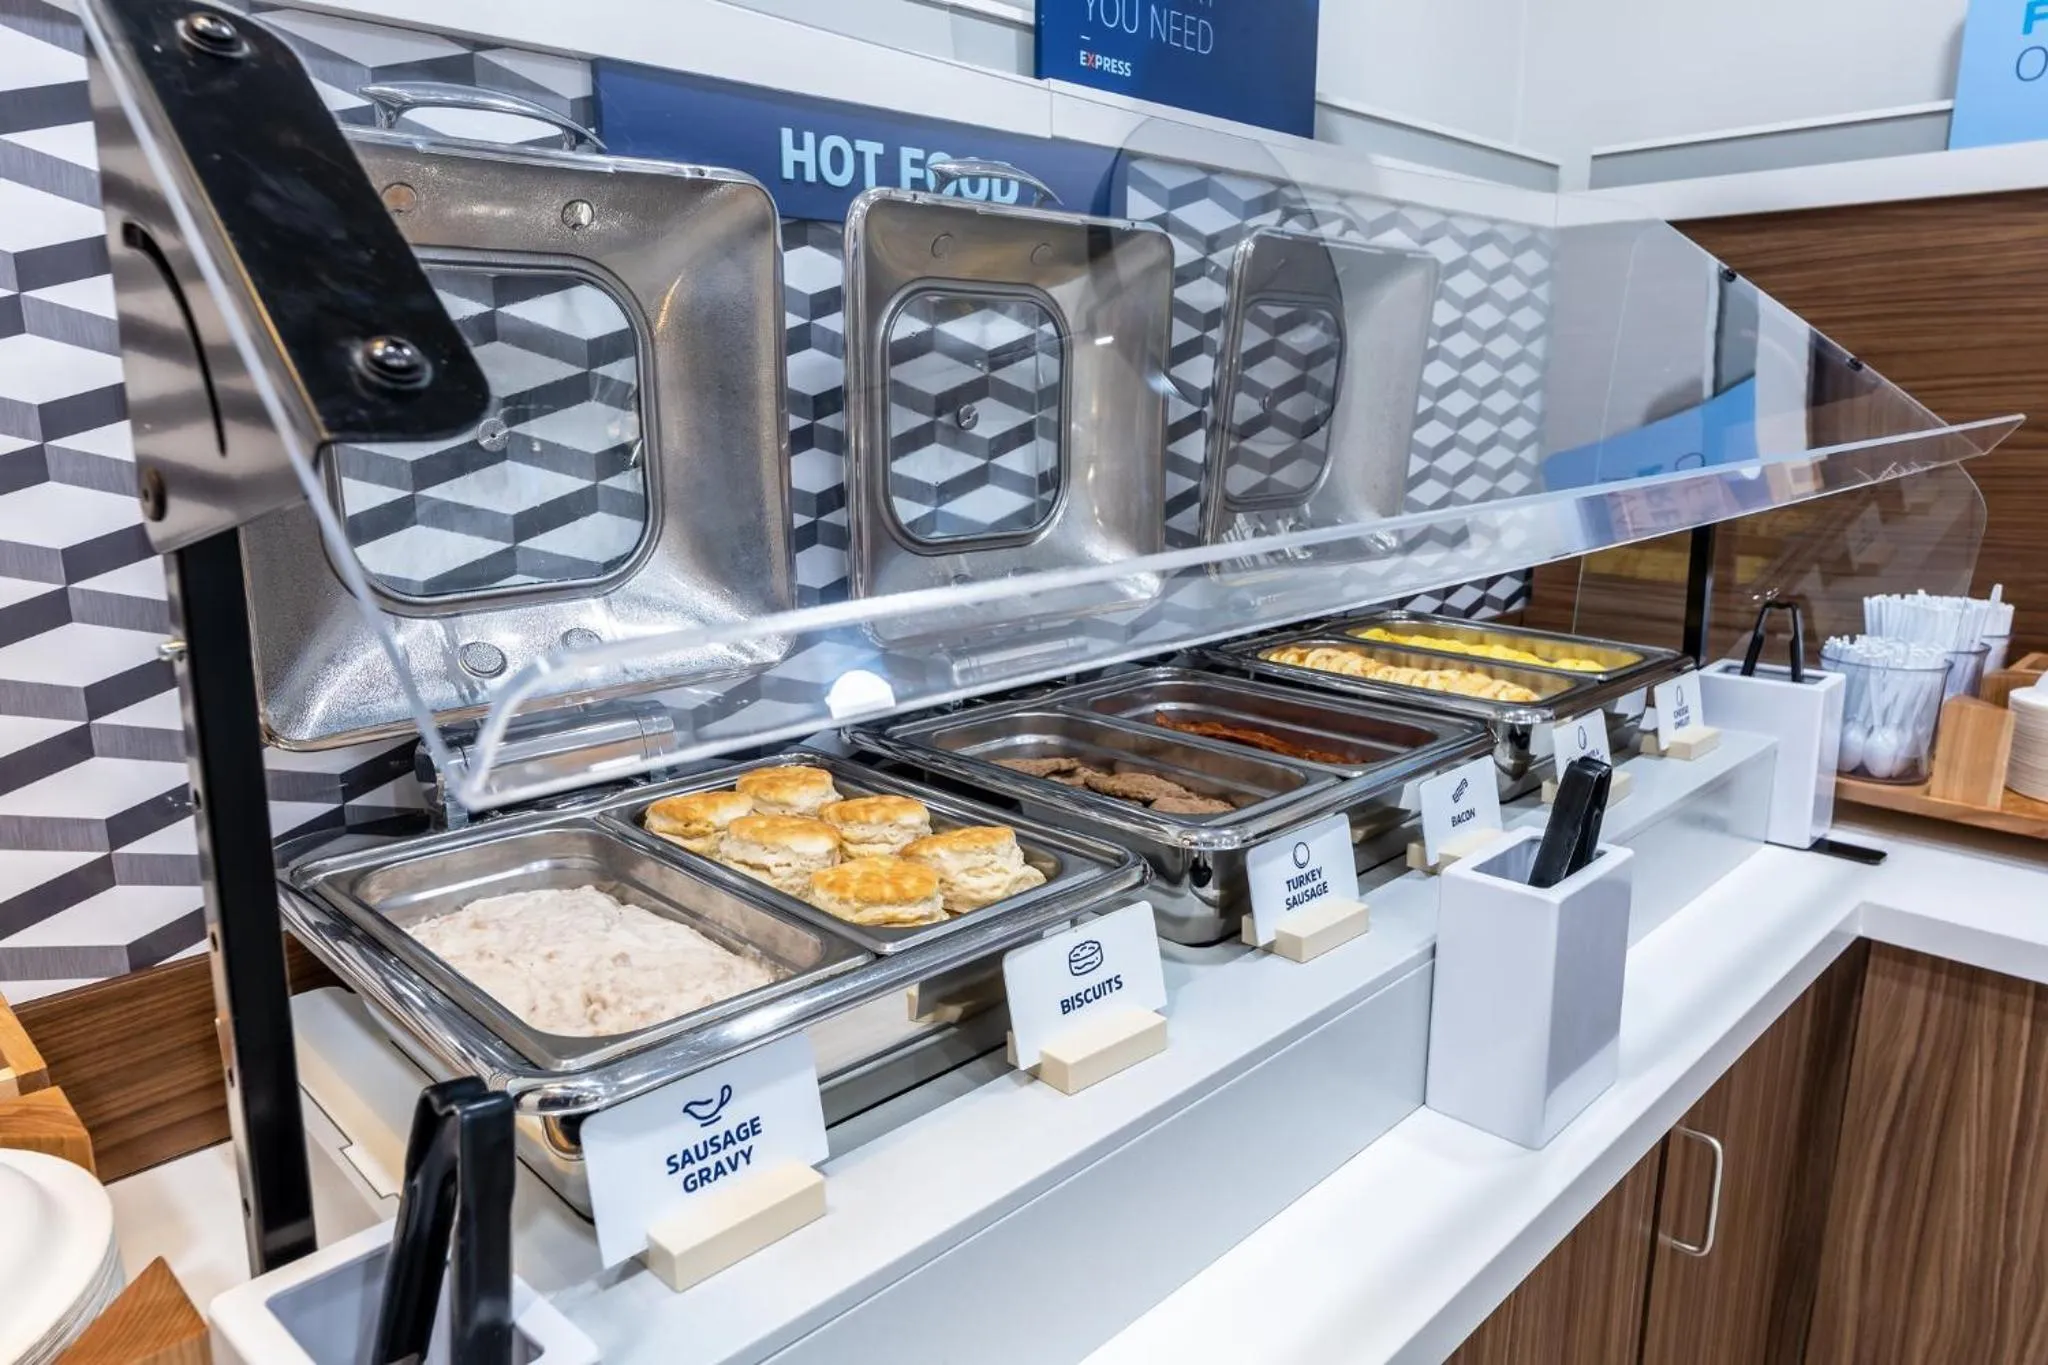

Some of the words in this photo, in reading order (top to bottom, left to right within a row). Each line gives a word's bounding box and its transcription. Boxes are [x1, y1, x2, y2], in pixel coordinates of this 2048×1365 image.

[1085, 0, 1139, 34] YOU
[1150, 4, 1214, 54] NEED
[1079, 50, 1132, 77] EXPRESS
[780, 127, 884, 189] HOT
[1450, 807, 1476, 828] BACON
[1285, 866, 1323, 893] TURKEY
[1285, 881, 1329, 911] SAUSAGE
[1060, 974, 1123, 1015] BISCUITS
[665, 1115, 763, 1175] SAUSAGE
[682, 1144, 754, 1194] GRAVY
